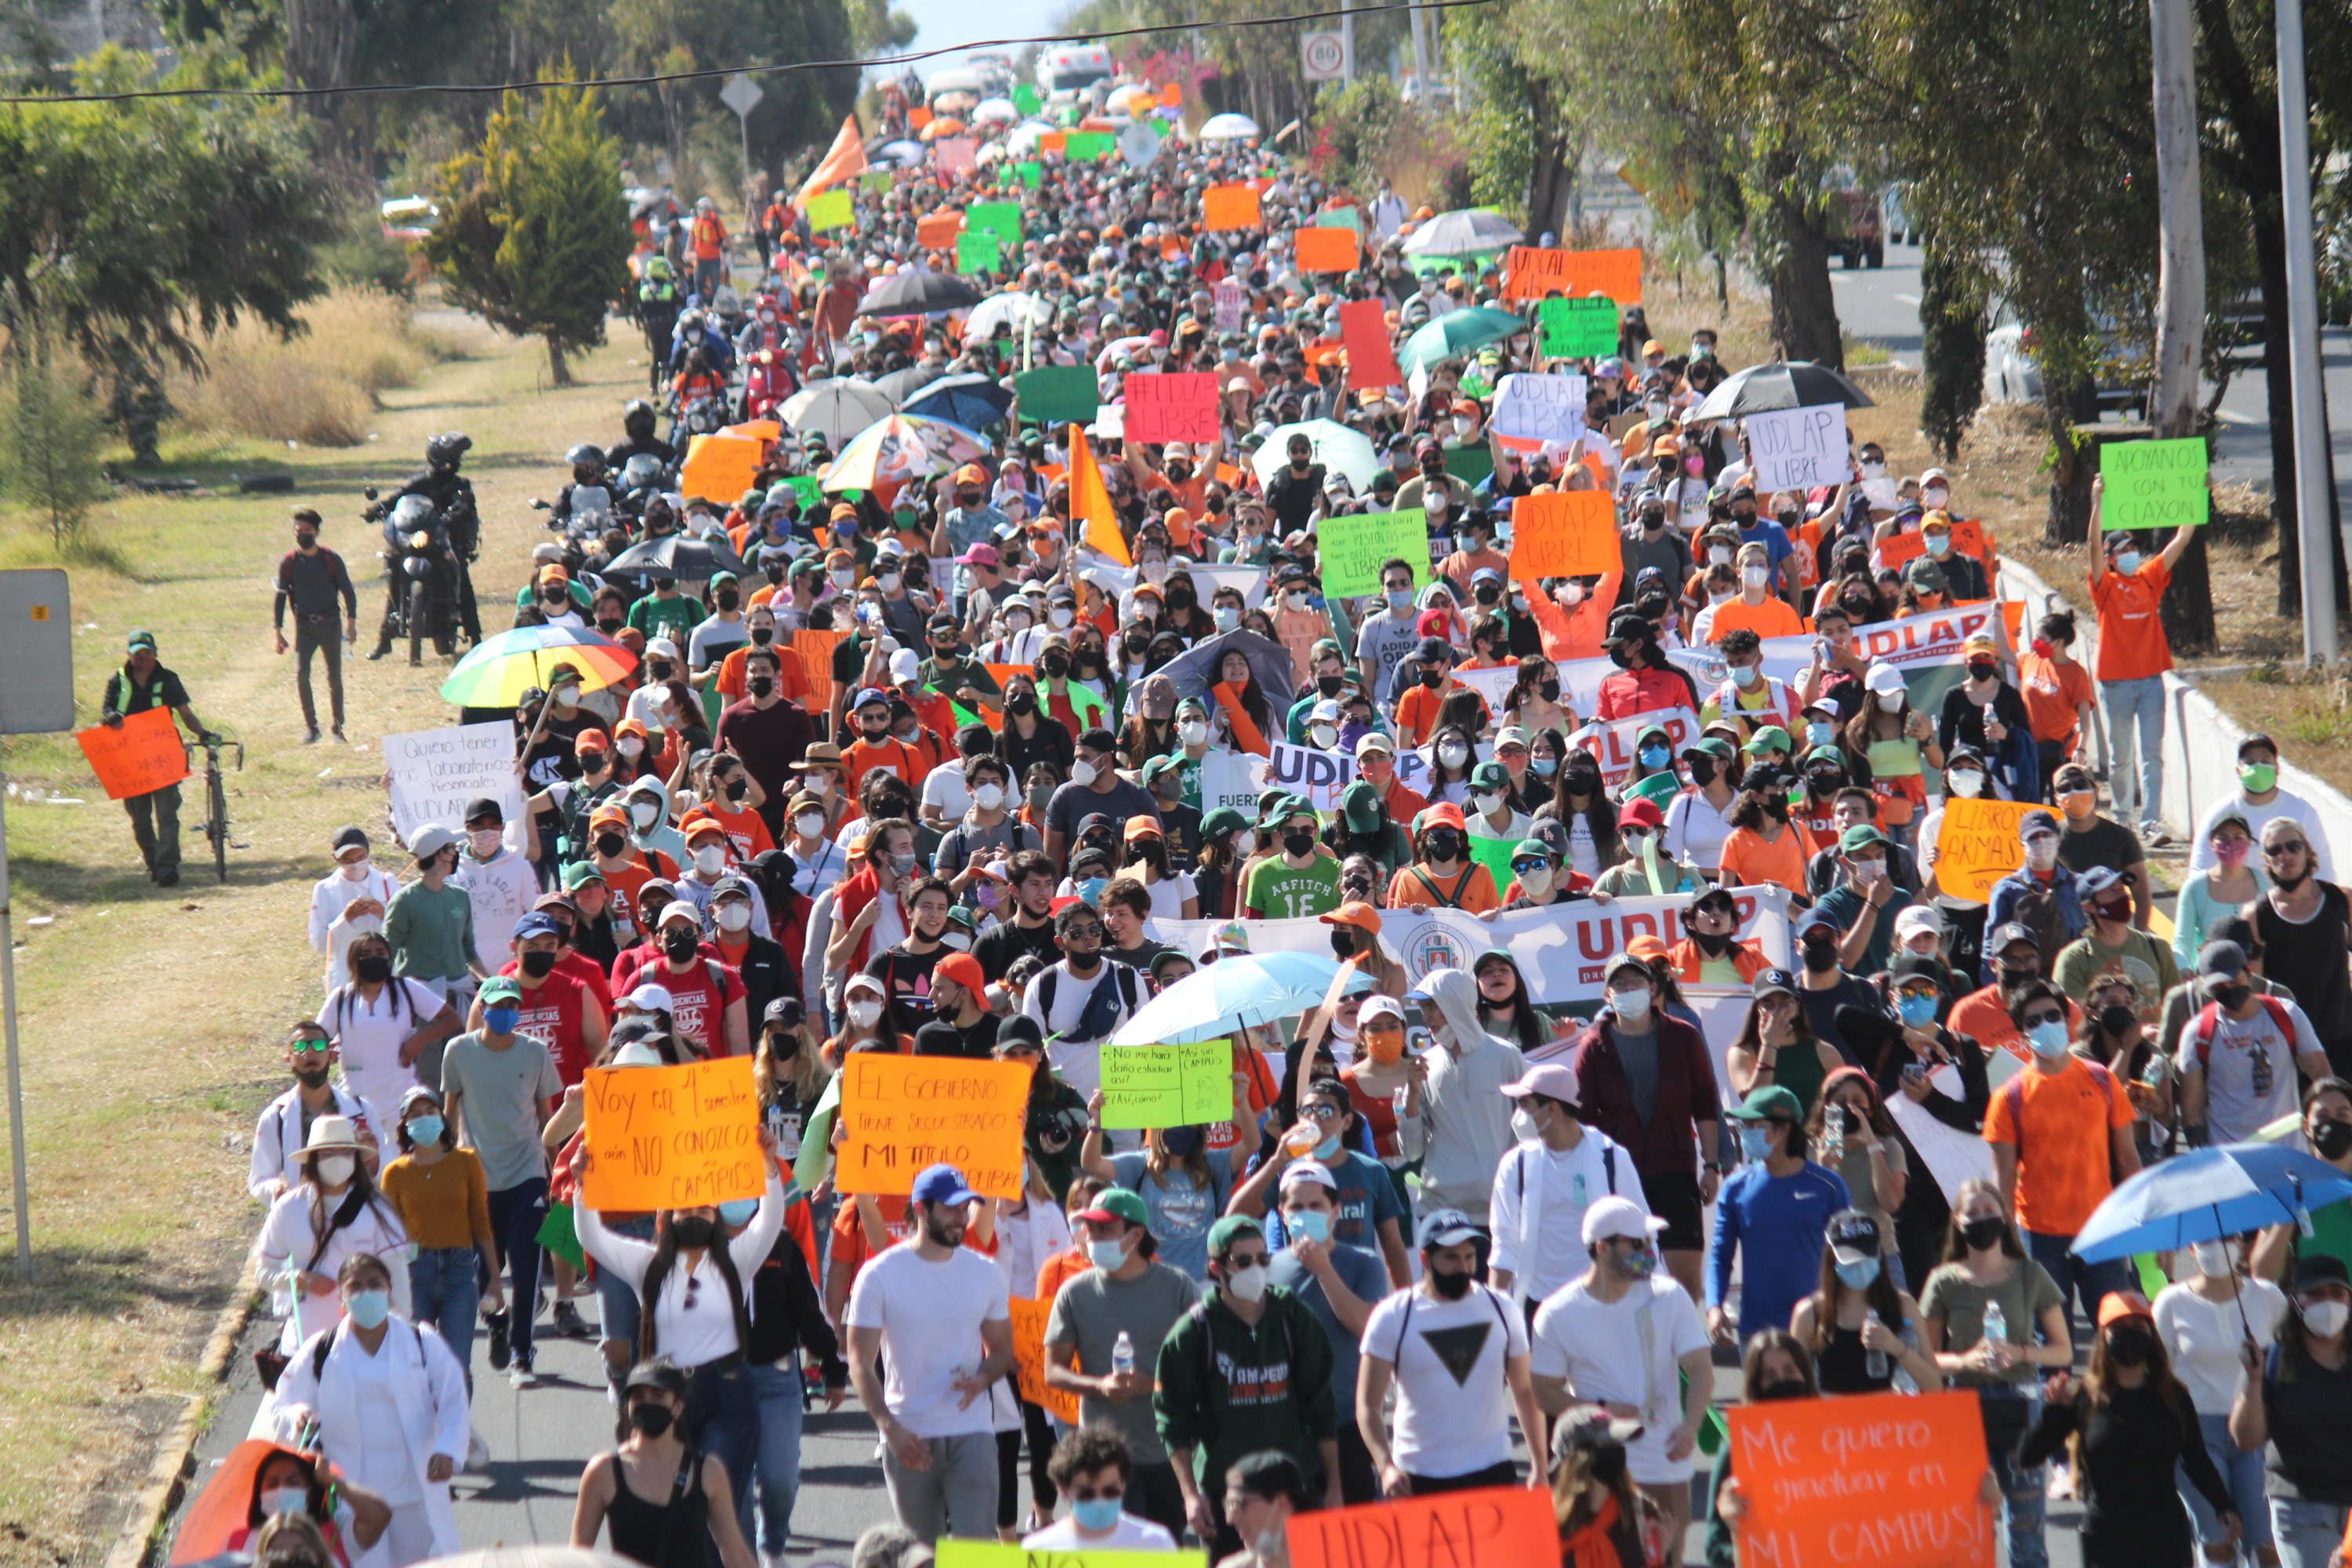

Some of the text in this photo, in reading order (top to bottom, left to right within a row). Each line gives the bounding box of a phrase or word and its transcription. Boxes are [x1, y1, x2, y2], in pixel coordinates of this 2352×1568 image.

[1127, 376, 1214, 403] #UDLAP
[1512, 377, 1583, 404] UDLAP
[1142, 407, 1213, 438] LIBRE
[1498, 402, 1584, 437] LIBRE
[1756, 410, 1832, 456] UDLAP
[2115, 445, 2198, 474] APOYANOS
[2133, 475, 2198, 497] CON TU
[1515, 499, 1597, 534] UDLAP
[2118, 499, 2195, 524] CLAXON
[1354, 530, 1399, 547] PISTOLAS
[1526, 538, 1592, 568] LIBRE
[1381, 641, 1416, 653] ADIDA
[404, 733, 498, 759] Quiero tener
[393, 757, 510, 784] mis laboratorios
[1272, 746, 1425, 786] UDLP
[1219, 793, 1259, 808] FUERZ
[1940, 833, 2016, 866] ARMAS
[1272, 879, 1332, 897] A&FITCH
[1577, 895, 1756, 960] UDLP
[1136, 1051, 1149, 1059] me
[1183, 1056, 1222, 1070] CAMPUS
[1201, 1047, 1214, 1056] sin
[857, 1061, 999, 1102] EL GOBIERNO
[1110, 1061, 1173, 1073] daño estudiar
[589, 1070, 637, 1133] Voy
[652, 1087, 675, 1117] en
[704, 1080, 750, 1112] semestre
[854, 1112, 1007, 1133] TIENE SECUESTRADO
[633, 1135, 662, 1177] NO
[673, 1123, 749, 1157] CONOZCO
[862, 1143, 896, 1168] MI
[671, 1162, 755, 1206] CAMPUS
[1740, 1419, 1932, 1472] Me quiero
[1773, 1461, 1946, 1514] graduar en
[1319, 1503, 1505, 1568] UDLAP
[1747, 1504, 1984, 1568] MI CAMPUS!
